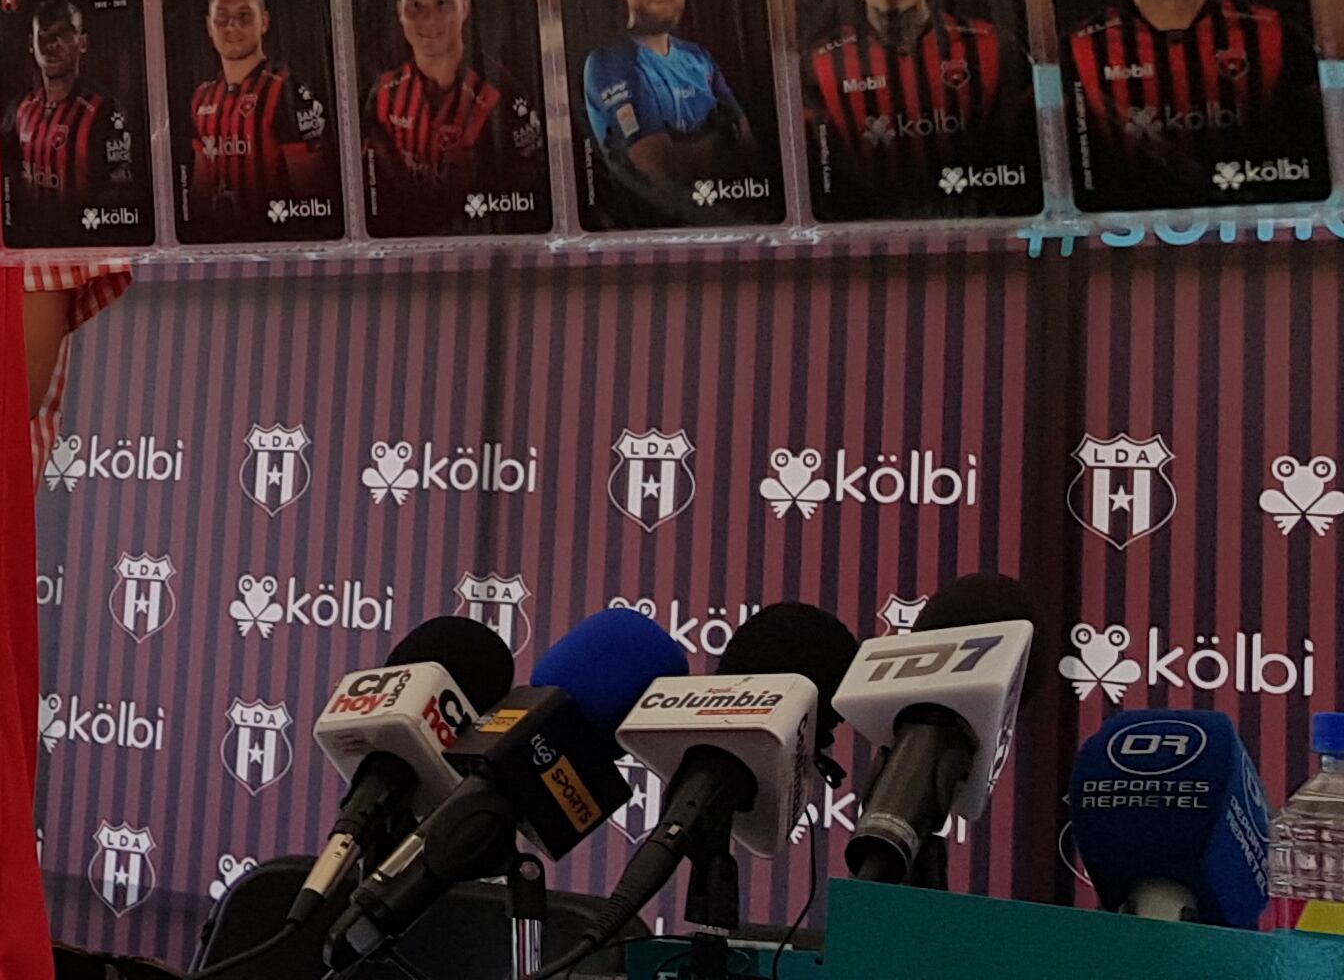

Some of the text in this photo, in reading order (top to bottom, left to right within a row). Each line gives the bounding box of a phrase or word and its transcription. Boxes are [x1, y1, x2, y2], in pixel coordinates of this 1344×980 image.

[967, 165, 1027, 188] kölbi
[1243, 157, 1312, 183] kölbi
[718, 178, 770, 201] kölbi
[288, 198, 332, 217] kölbi
[488, 191, 535, 212] kölbi
[100, 207, 141, 226] kölbi
[258, 434, 296, 449] LDA
[629, 440, 676, 457] LDA
[88, 435, 184, 482] kölbi
[420, 440, 538, 494] kölbi
[1093, 448, 1151, 465] LDA
[835, 448, 978, 507] kölbi
[126, 564, 162, 578] LDA
[471, 583, 513, 599] LDA
[285, 576, 394, 631] kölbi
[864, 634, 1005, 682] TD7
[1148, 626, 1314, 696] kölbi
[328, 693, 389, 715] hoy
[639, 690, 784, 709] Columbia
[68, 695, 165, 750] kölbi
[239, 709, 278, 726] LDA
[422, 695, 459, 749] ho
[1120, 734, 1191, 755] DR
[551, 768, 595, 824] SPORTS
[1082, 779, 1211, 794] DEPORTES
[1080, 795, 1209, 809] REPRETEL
[107, 833, 142, 849] LDA
